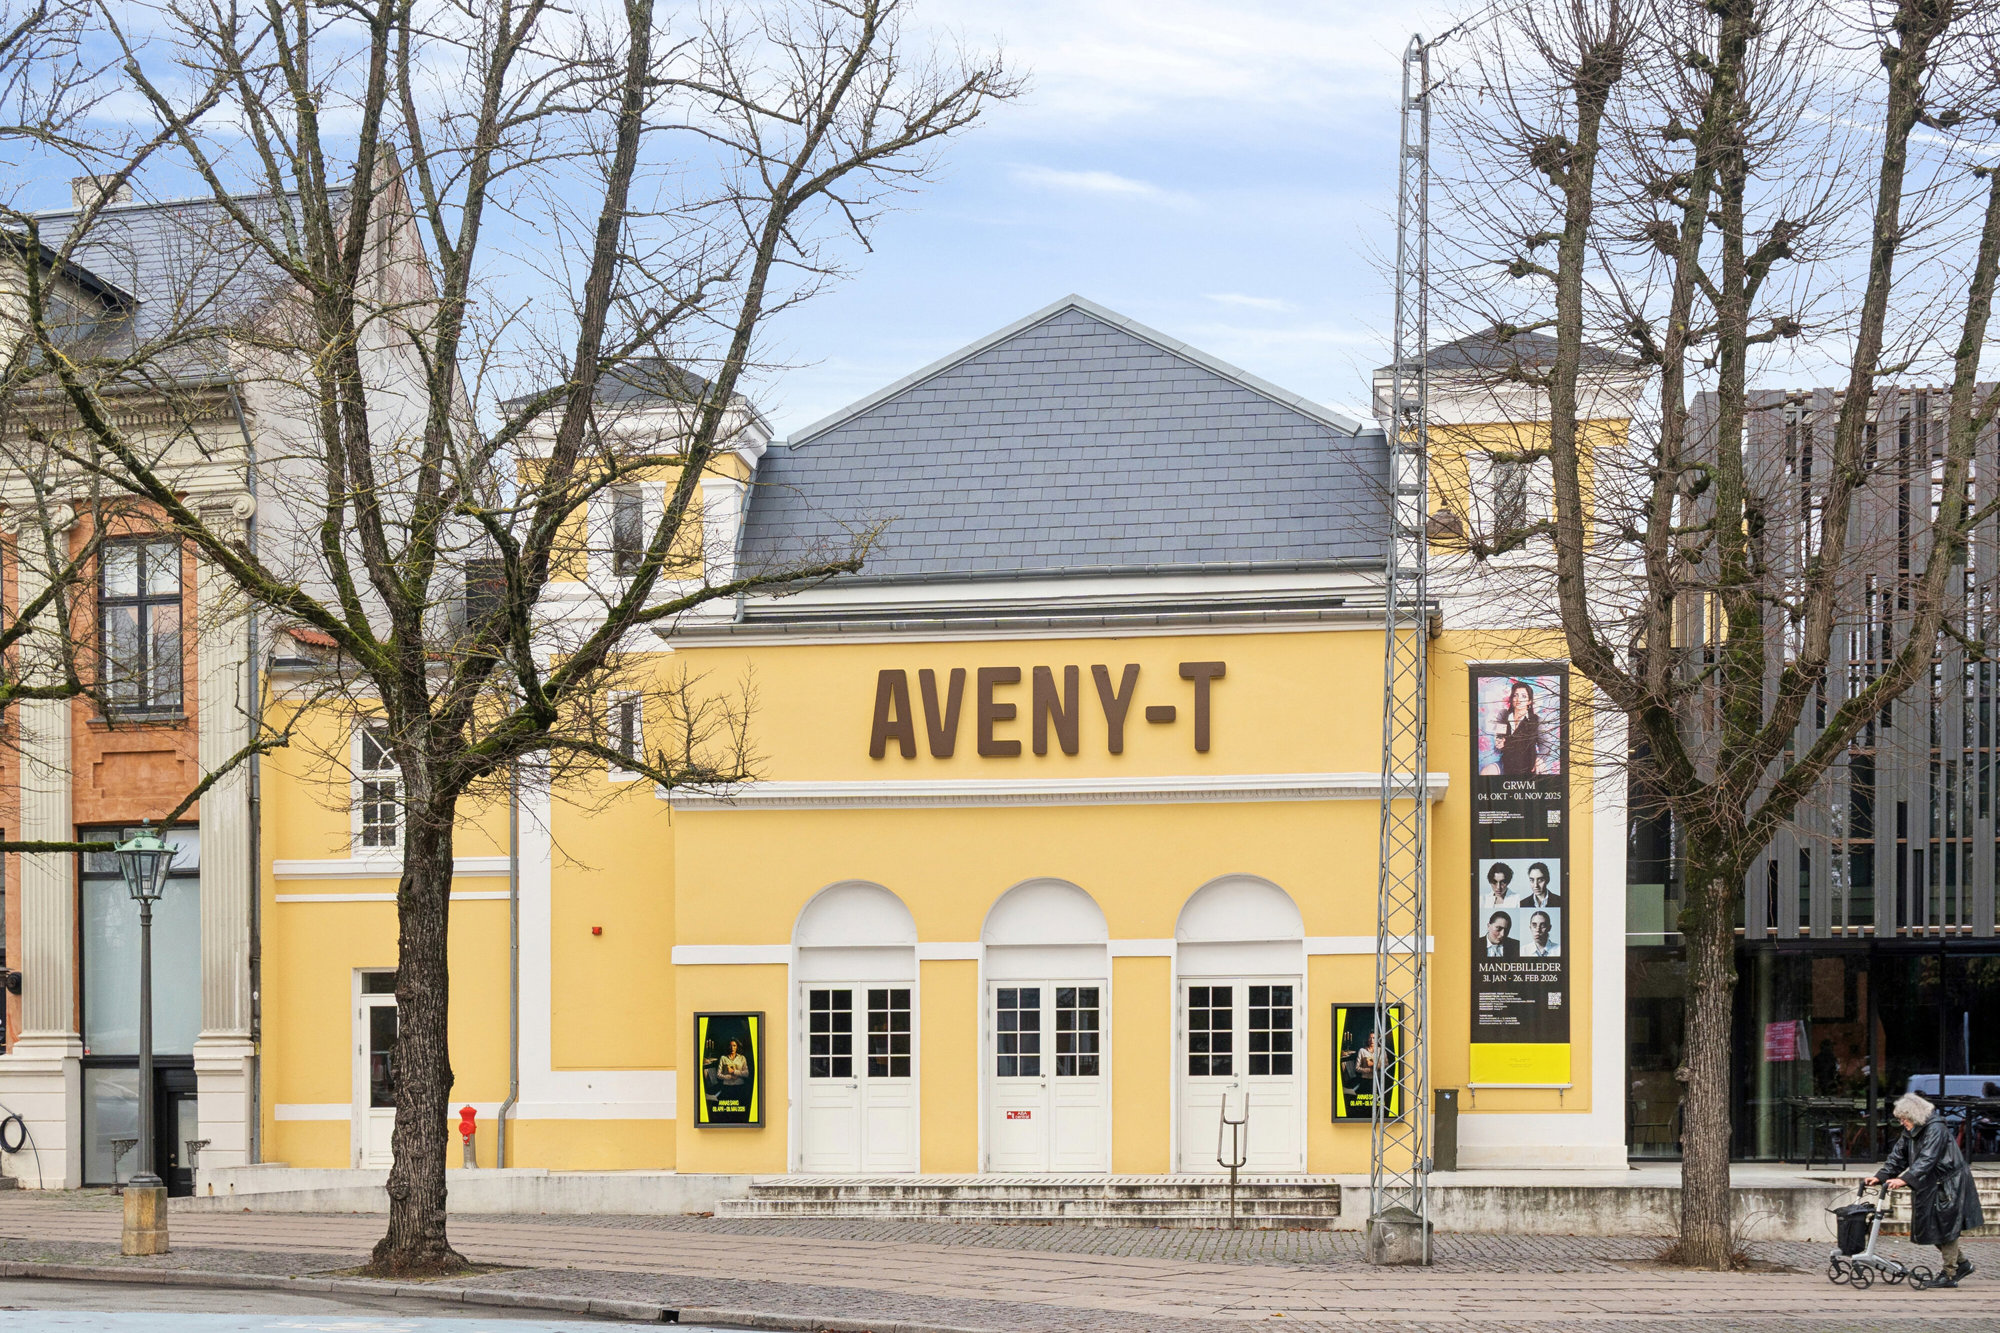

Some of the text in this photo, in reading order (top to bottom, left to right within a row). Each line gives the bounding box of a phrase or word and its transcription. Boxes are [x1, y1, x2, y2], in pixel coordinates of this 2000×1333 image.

[869, 661, 1226, 759] AVENY-T
[1502, 781, 1536, 790] GRWM
[1490, 792, 1508, 800] OKT
[1524, 792, 1543, 800] NOV
[1544, 792, 1561, 800] 2025
[1479, 962, 1561, 972] MANDEBILLEDER
[1492, 974, 1507, 983] JAN
[1524, 974, 1539, 982] FEB
[1540, 974, 1558, 982] 2026
